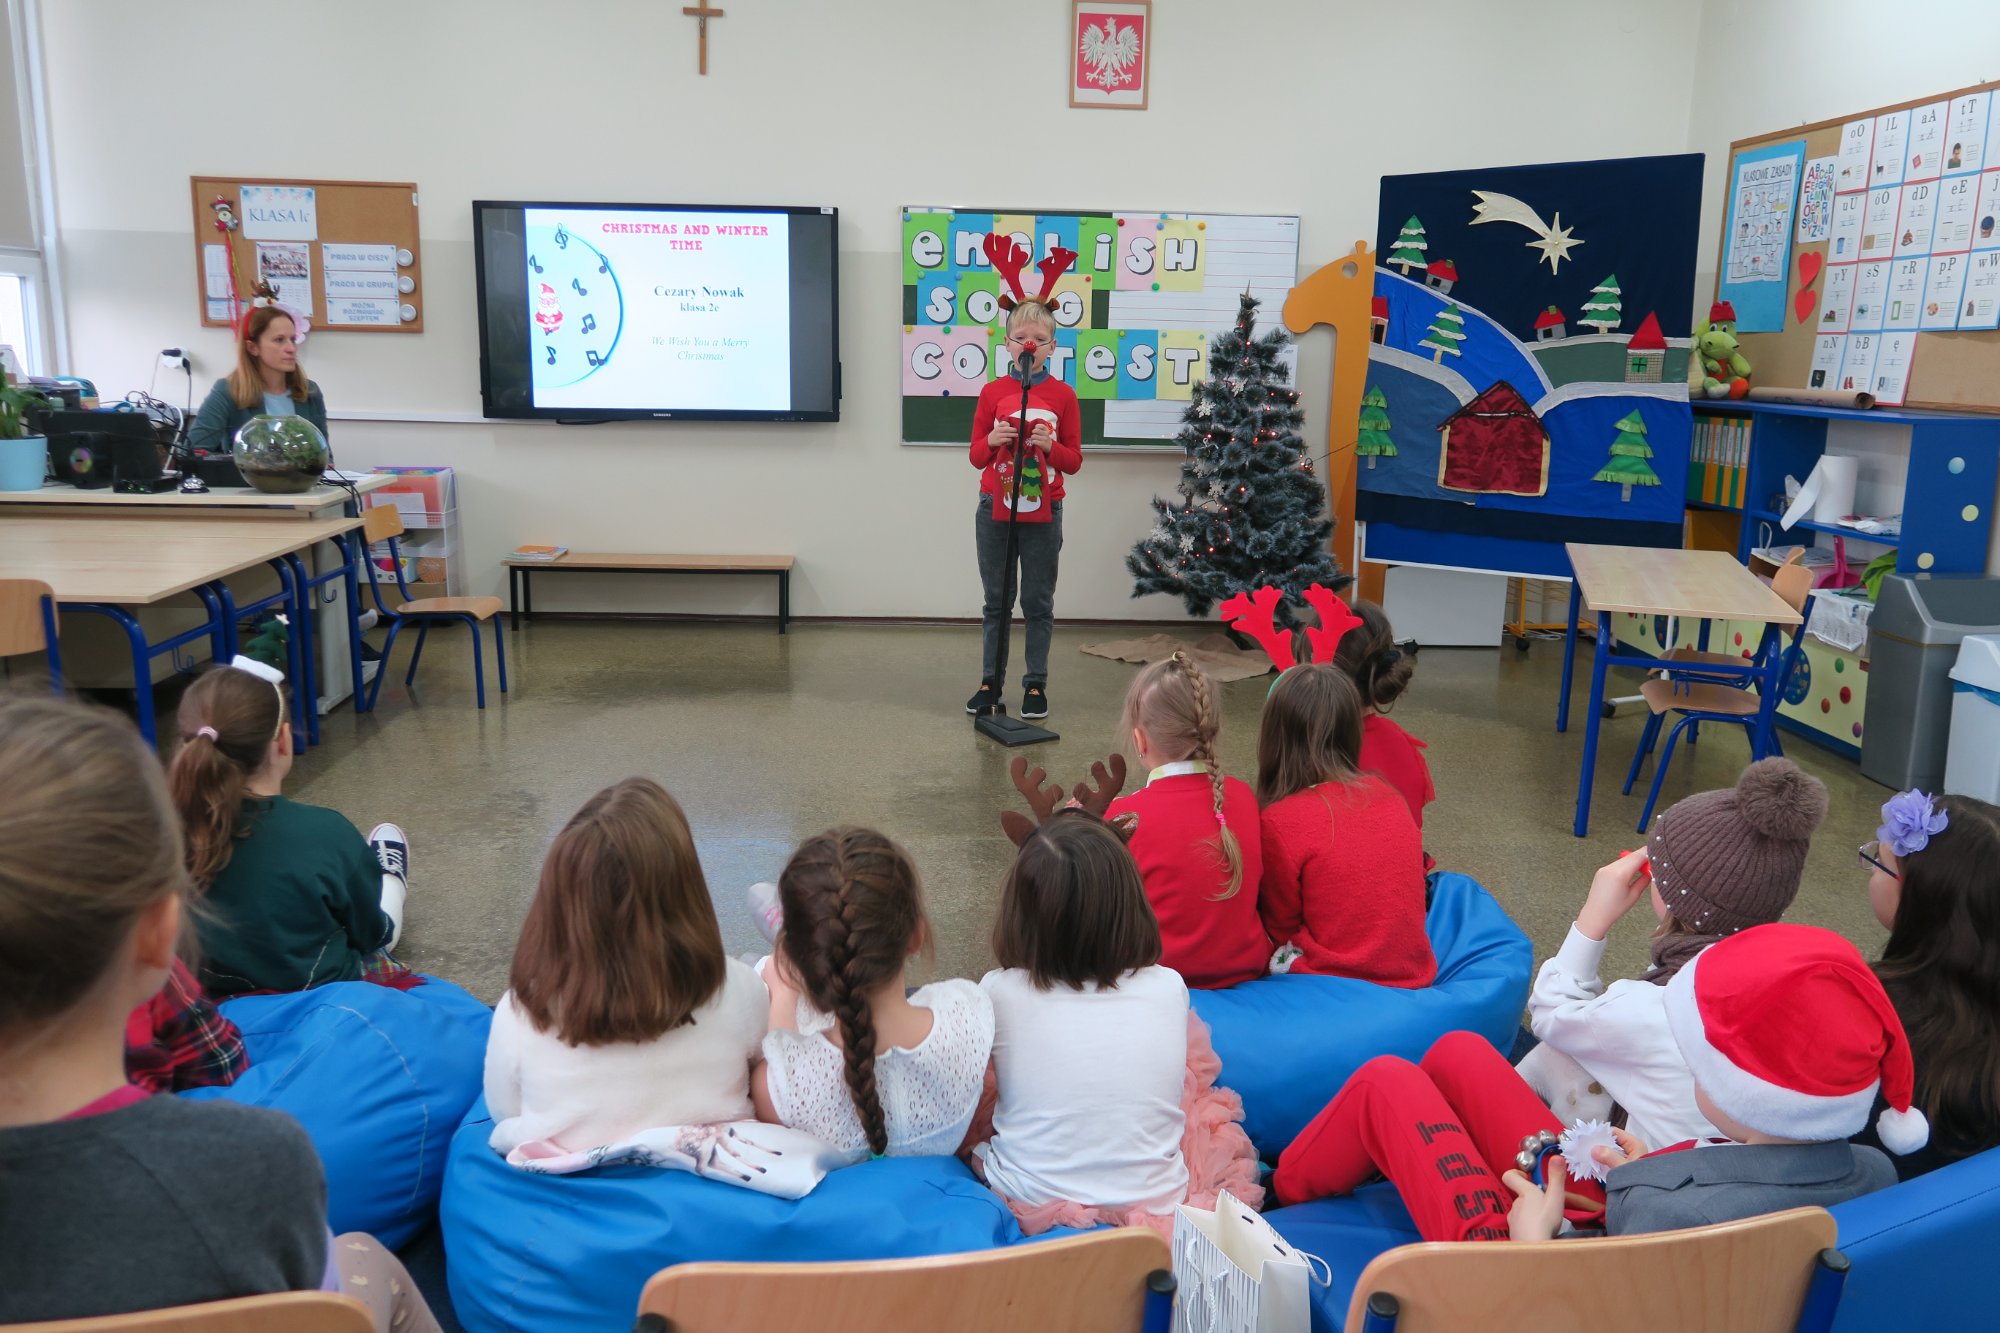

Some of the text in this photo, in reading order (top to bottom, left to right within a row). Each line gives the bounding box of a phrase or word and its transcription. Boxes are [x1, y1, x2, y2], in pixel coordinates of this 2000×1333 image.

[1770, 163, 1794, 179] ZASADY
[249, 208, 297, 222] KLASA
[602, 223, 769, 237] CHRISTMAS AND WINTER
[669, 240, 703, 251] TIME
[330, 253, 357, 261] PRACA
[329, 280, 356, 288] PRACA
[654, 285, 745, 300] Cezary Nowak
[679, 302, 706, 312] klasa
[652, 336, 665, 346] We
[668, 336, 691, 346] Wish
[694, 337, 710, 346] You
[721, 337, 749, 350] Merry
[677, 351, 725, 361] Christmas
